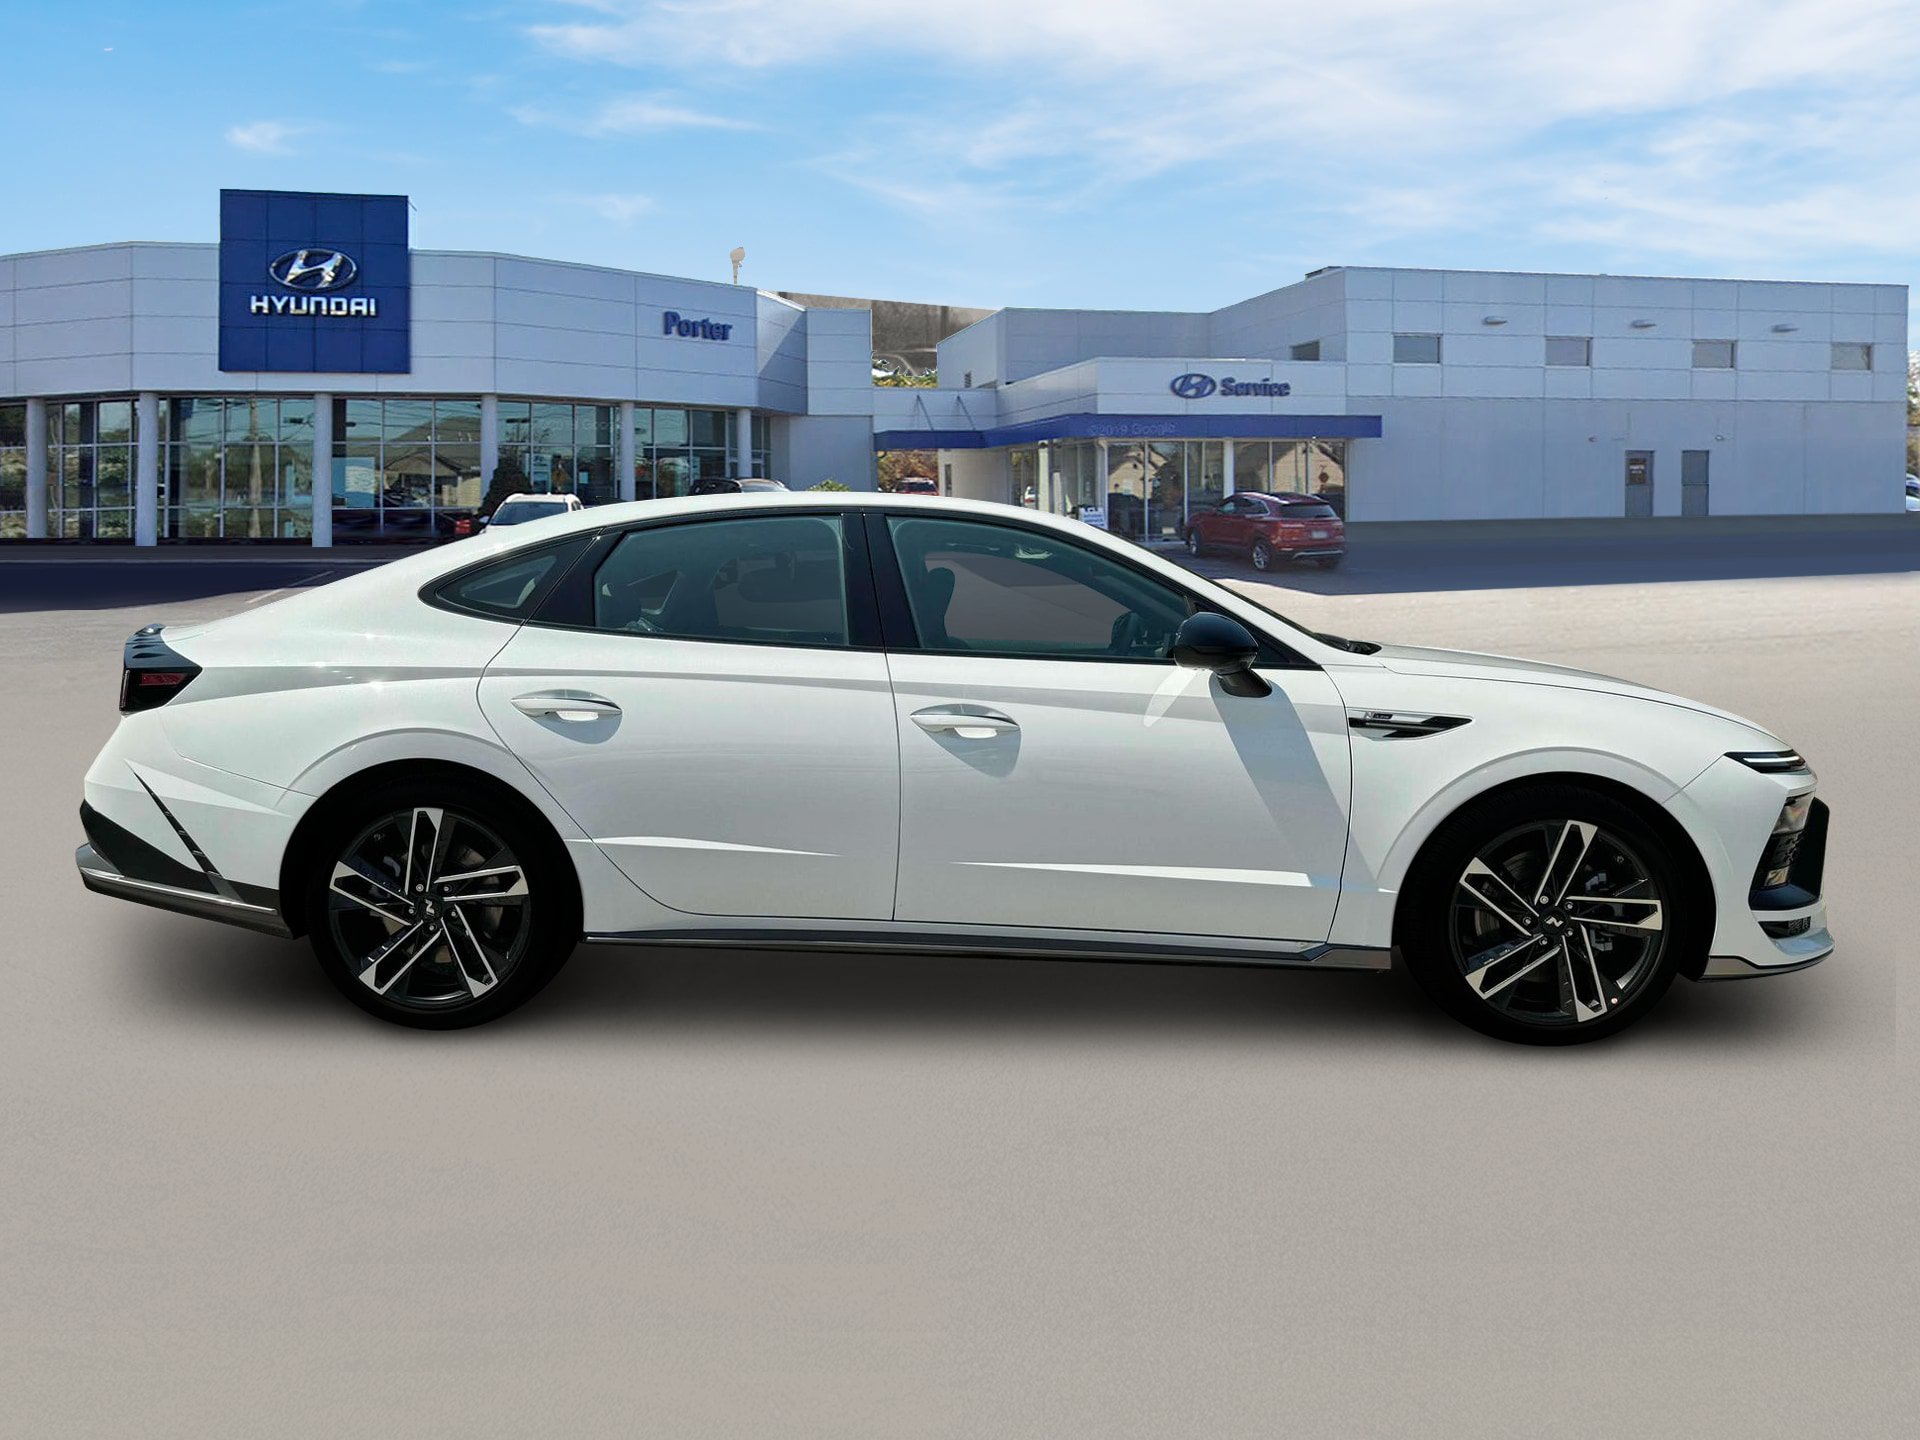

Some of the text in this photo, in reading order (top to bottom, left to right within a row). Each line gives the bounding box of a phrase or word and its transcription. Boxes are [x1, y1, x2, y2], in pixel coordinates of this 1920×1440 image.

[250, 295, 377, 316] HYUNDAI
[663, 311, 733, 341] Porter
[1220, 377, 1291, 397] Service
